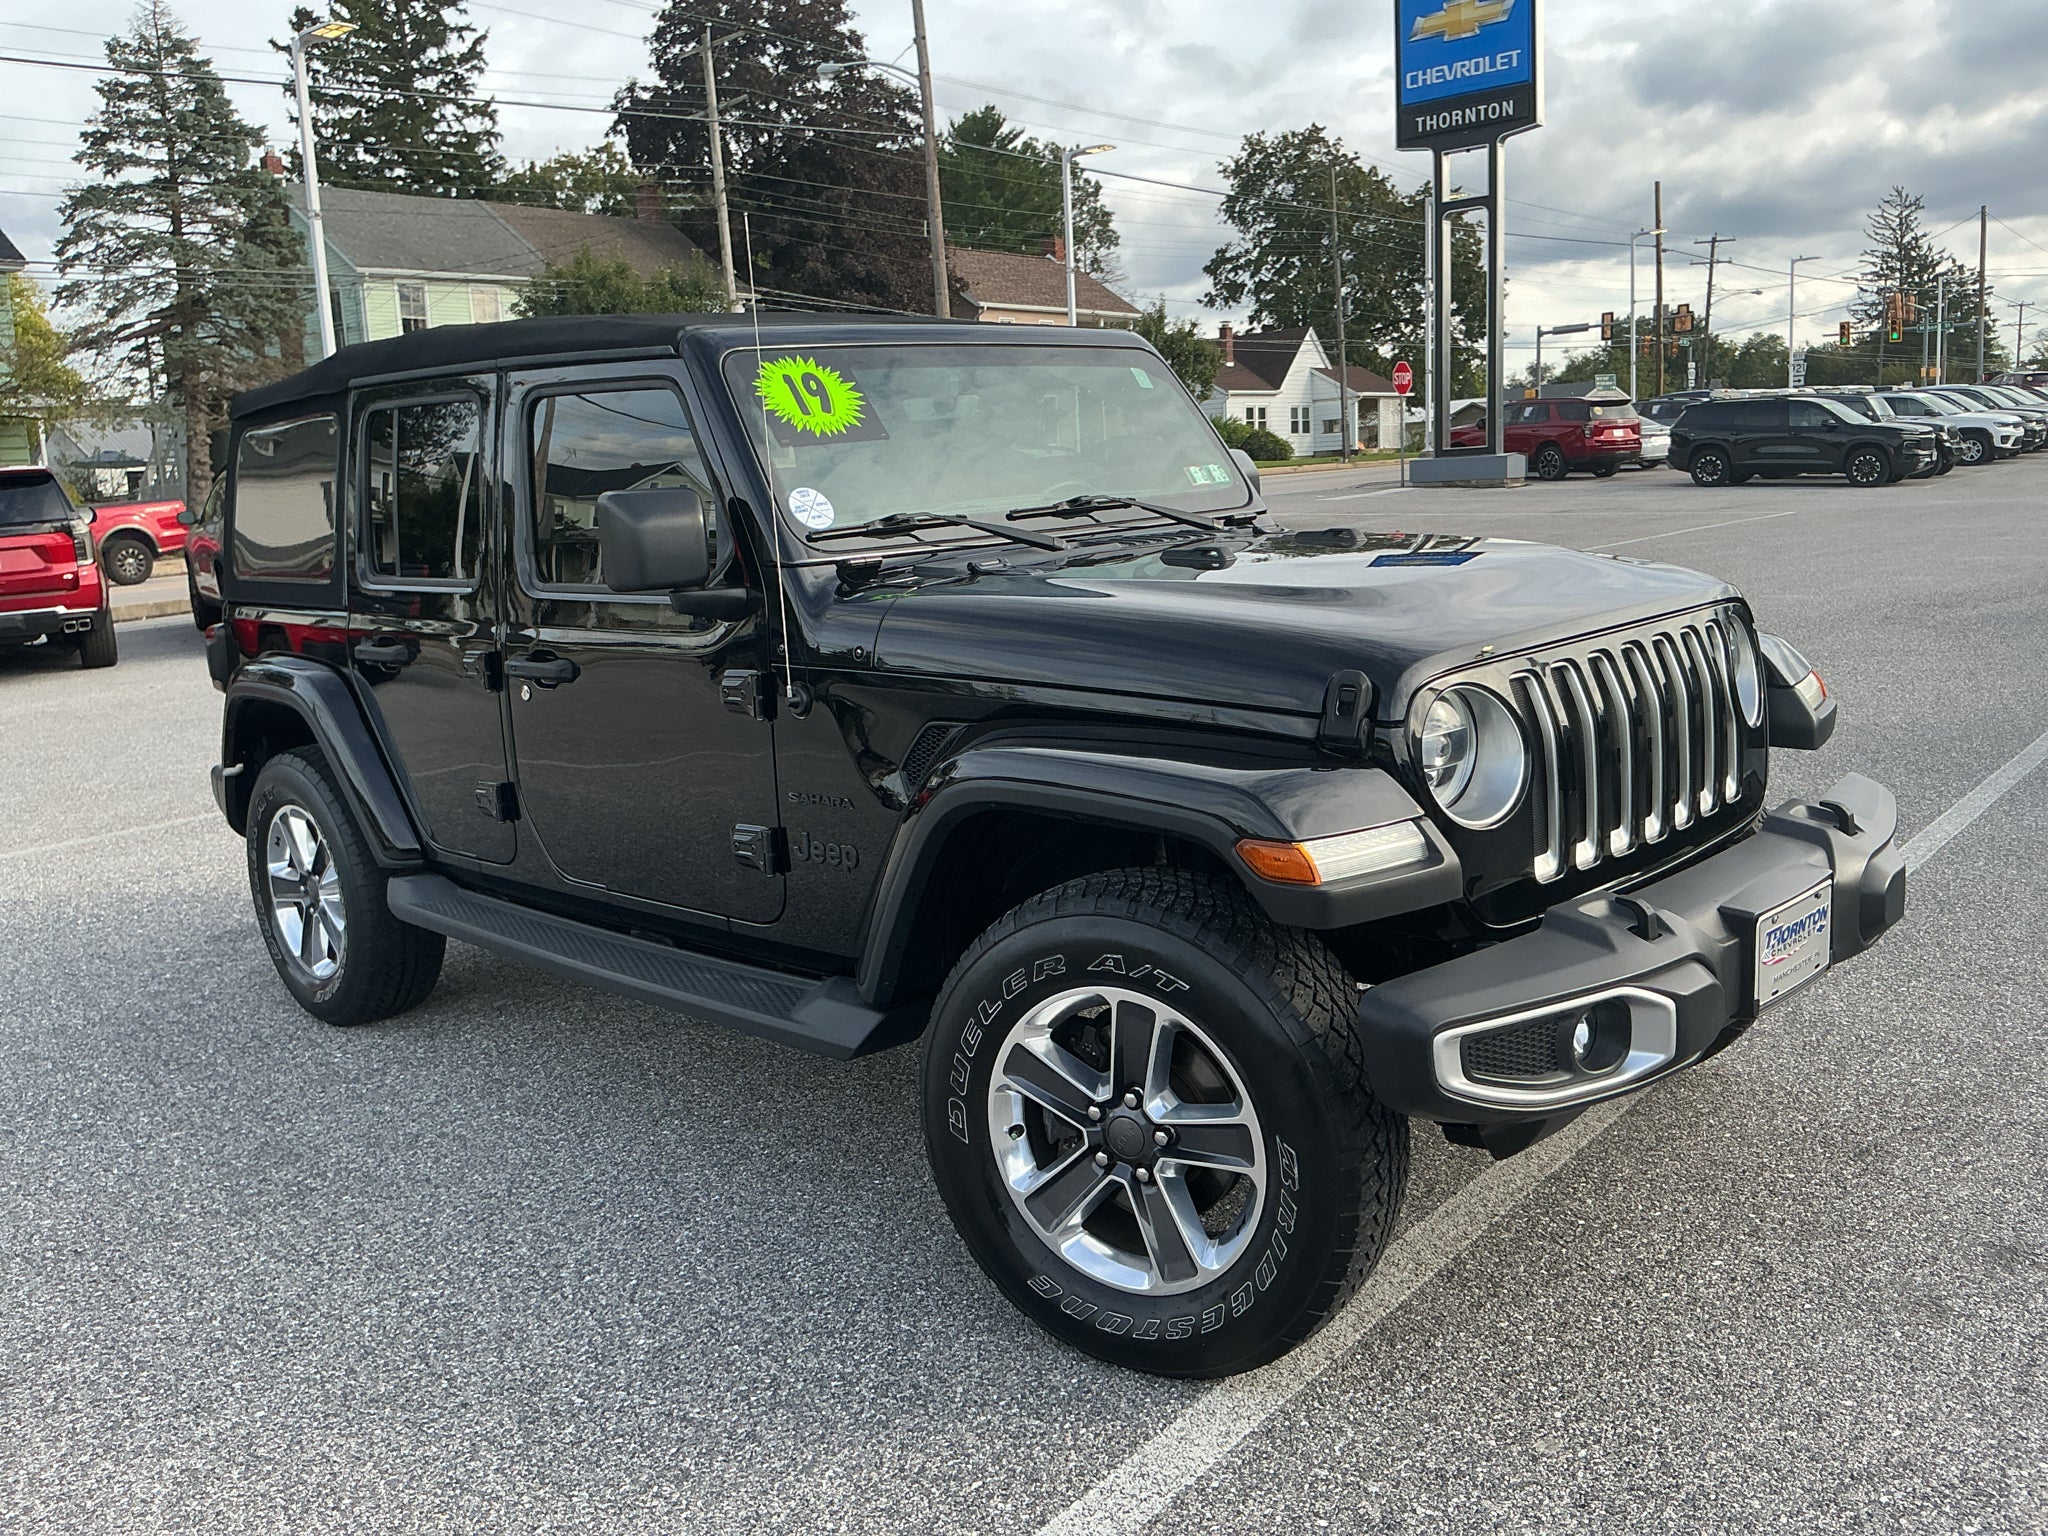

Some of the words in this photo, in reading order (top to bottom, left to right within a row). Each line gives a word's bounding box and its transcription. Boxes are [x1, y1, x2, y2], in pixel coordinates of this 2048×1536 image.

[1406, 50, 1521, 89] CHEVROLET
[1415, 99, 1514, 133] THORNTON
[782, 371, 835, 417] 19
[1394, 372, 1411, 385] STOP
[787, 792, 856, 810] SAHARA
[792, 831, 860, 874] Jeep
[1766, 904, 1829, 950] THORNTON
[1771, 926, 1816, 957] CHEVROLET
[948, 954, 1066, 1145] DUELER
[1087, 953, 1190, 992] A/T
[1027, 1135, 1299, 1340] BRIDGESTONE
